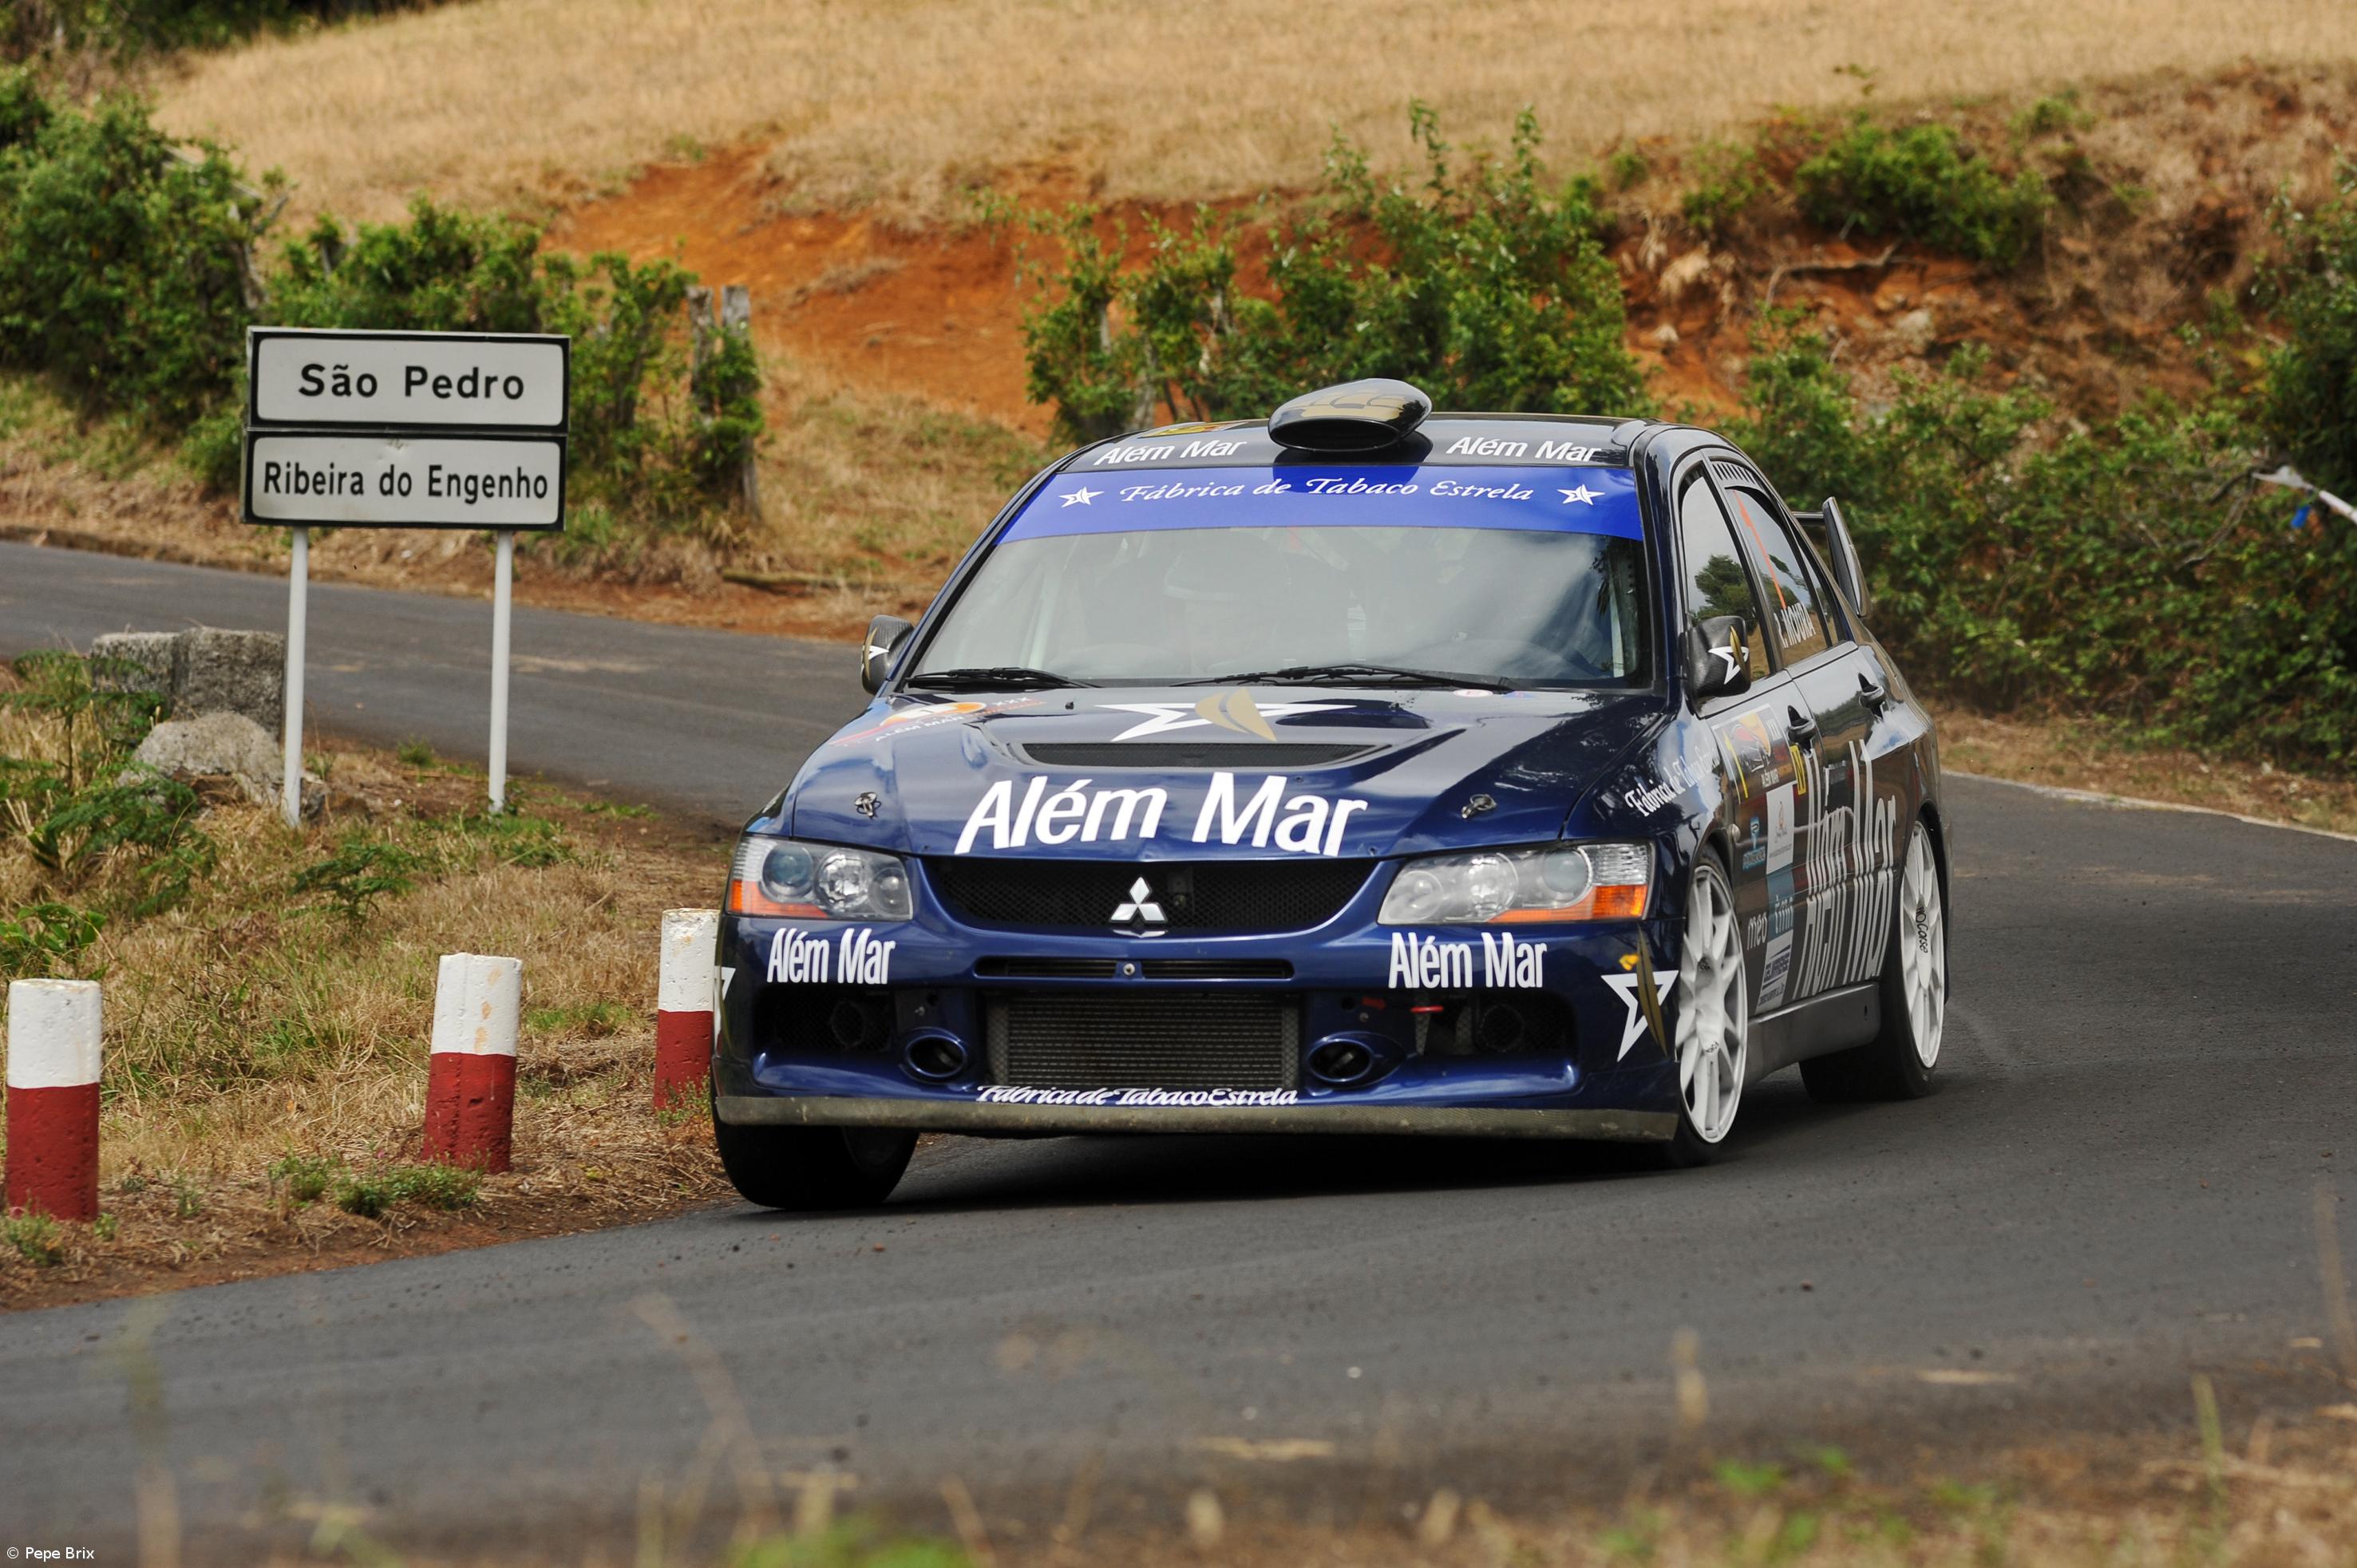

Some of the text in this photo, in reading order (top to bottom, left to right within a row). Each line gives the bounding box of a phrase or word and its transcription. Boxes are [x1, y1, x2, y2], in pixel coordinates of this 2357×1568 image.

[299, 363, 524, 399] São Pedro
[1093, 439, 1248, 466] Além Mar
[1445, 436, 1603, 462] Além Mar
[263, 461, 548, 504] Ribeira do Engenho
[1120, 477, 1534, 502] Fábrica de Tabaco Estrela
[954, 772, 1368, 856] Além Mar
[767, 927, 896, 984] Além Mar
[1388, 932, 1547, 988] Além Mar
[1113, 1087, 1208, 1106] Tabaco
[1208, 1087, 1299, 1106] Estrela
